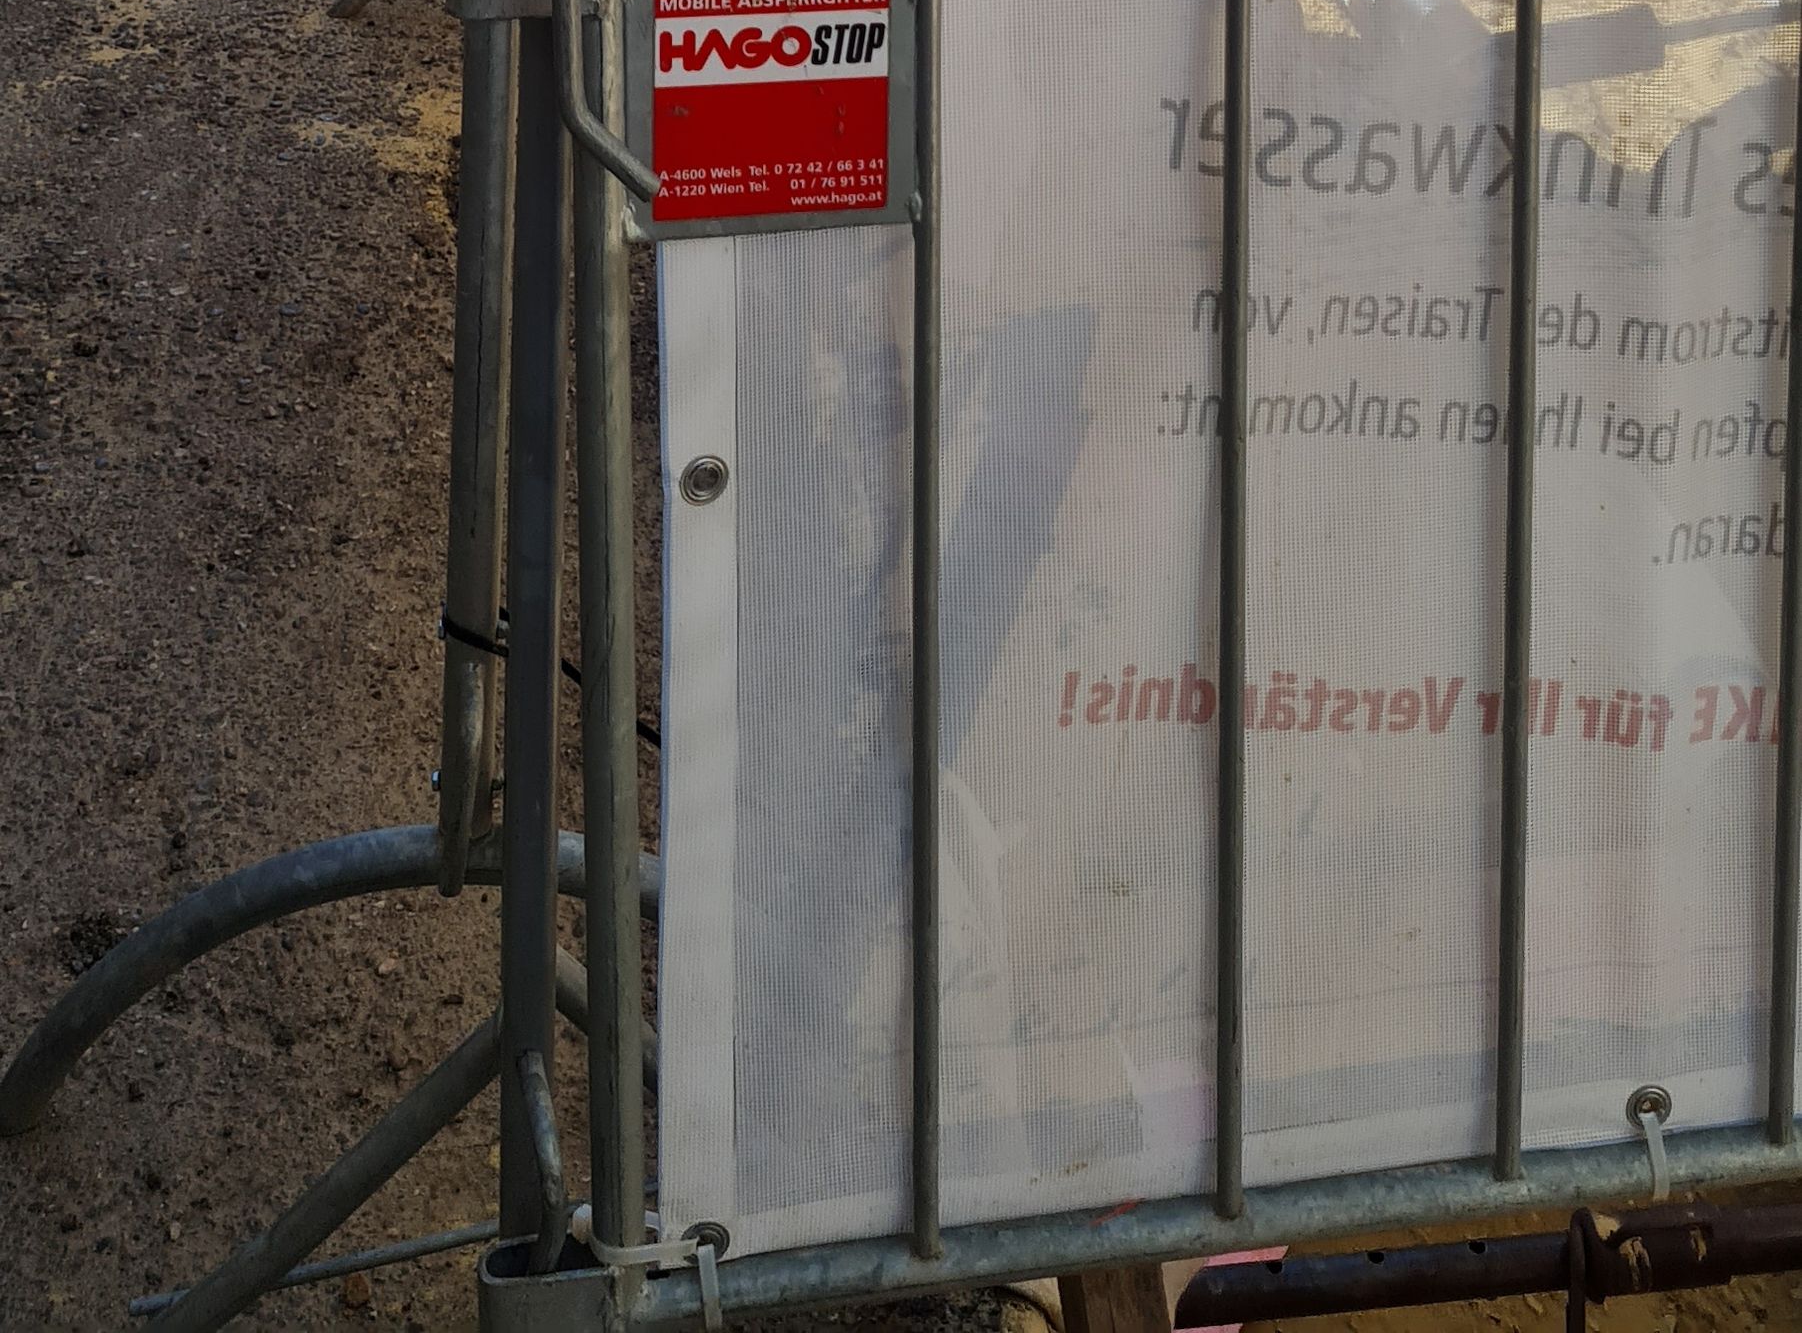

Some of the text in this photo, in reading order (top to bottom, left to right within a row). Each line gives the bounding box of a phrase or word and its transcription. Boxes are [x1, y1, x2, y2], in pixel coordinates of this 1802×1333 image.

[659, 168, 706, 182] A-4600
[710, 166, 742, 179] Wels
[749, 164, 770, 177] Tel.
[774, 163, 783, 175] 0
[786, 162, 803, 174] 72
[806, 161, 823, 173] 42
[836, 159, 853, 171] 66
[856, 159, 865, 170] 3
[868, 158, 884, 170] 41
[658, 185, 706, 198] A-1220
[710, 181, 744, 195] Wien
[749, 181, 770, 193] Tel.
[790, 178, 805, 190] 01
[820, 176, 836, 188] 76
[840, 175, 855, 187] 91
[859, 174, 883, 186] 511
[790, 191, 883, 206] www.hago.at
